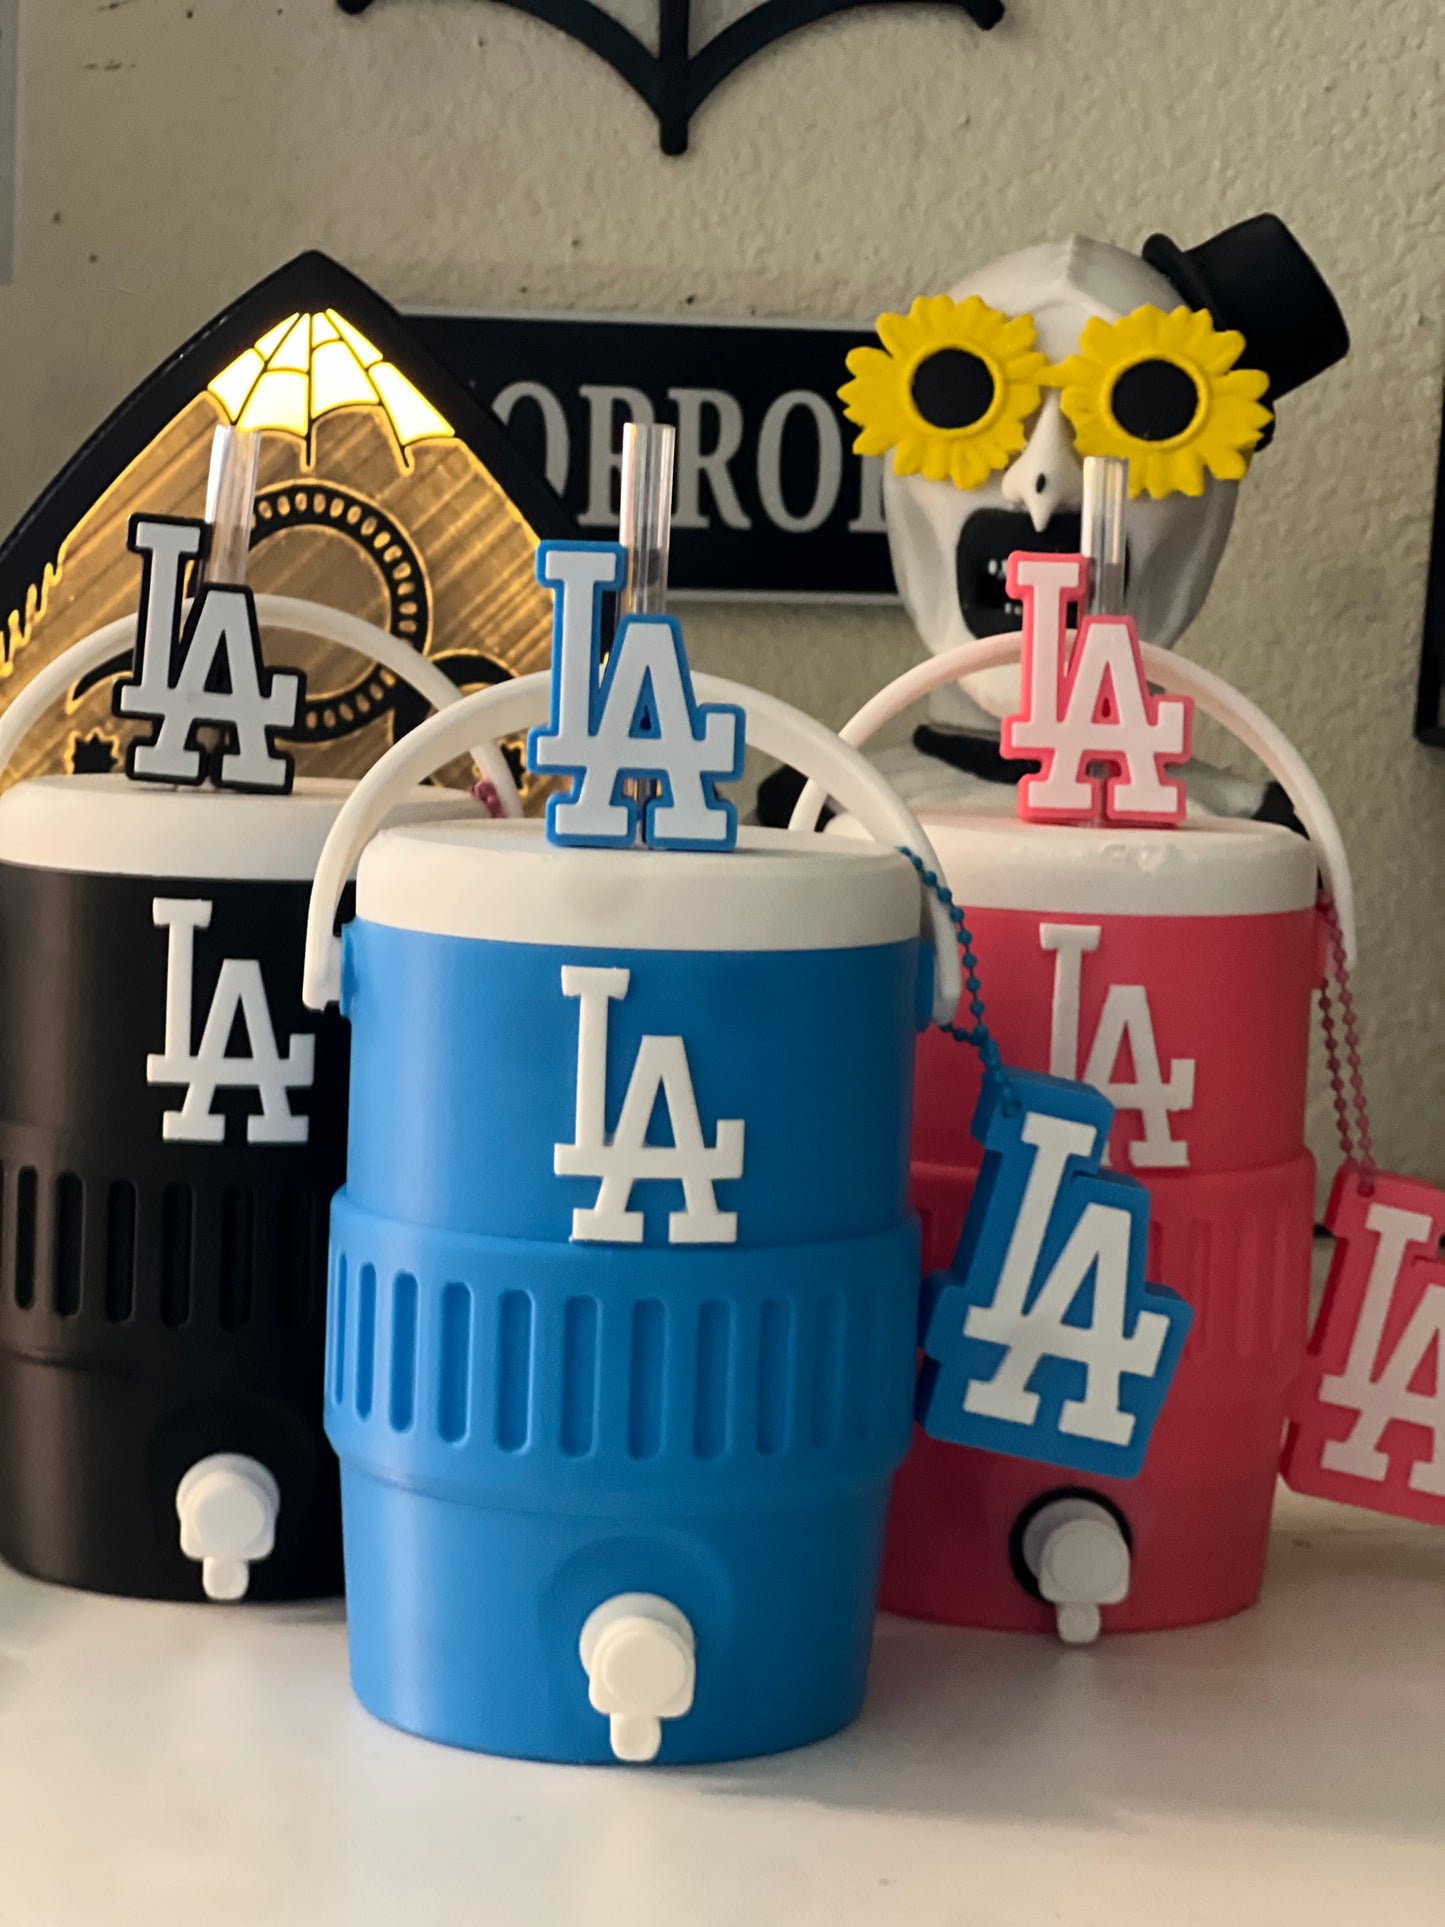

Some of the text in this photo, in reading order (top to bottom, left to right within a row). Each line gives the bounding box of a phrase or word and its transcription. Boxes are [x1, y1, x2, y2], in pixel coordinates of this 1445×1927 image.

[120, 520, 299, 788] LA
[536, 549, 738, 844] LA
[1011, 560, 1185, 813] LA
[146, 897, 316, 1143] LA
[553, 964, 746, 1244] LA
[1039, 922, 1196, 1168] LA
[962, 1111, 1171, 1447] LA
